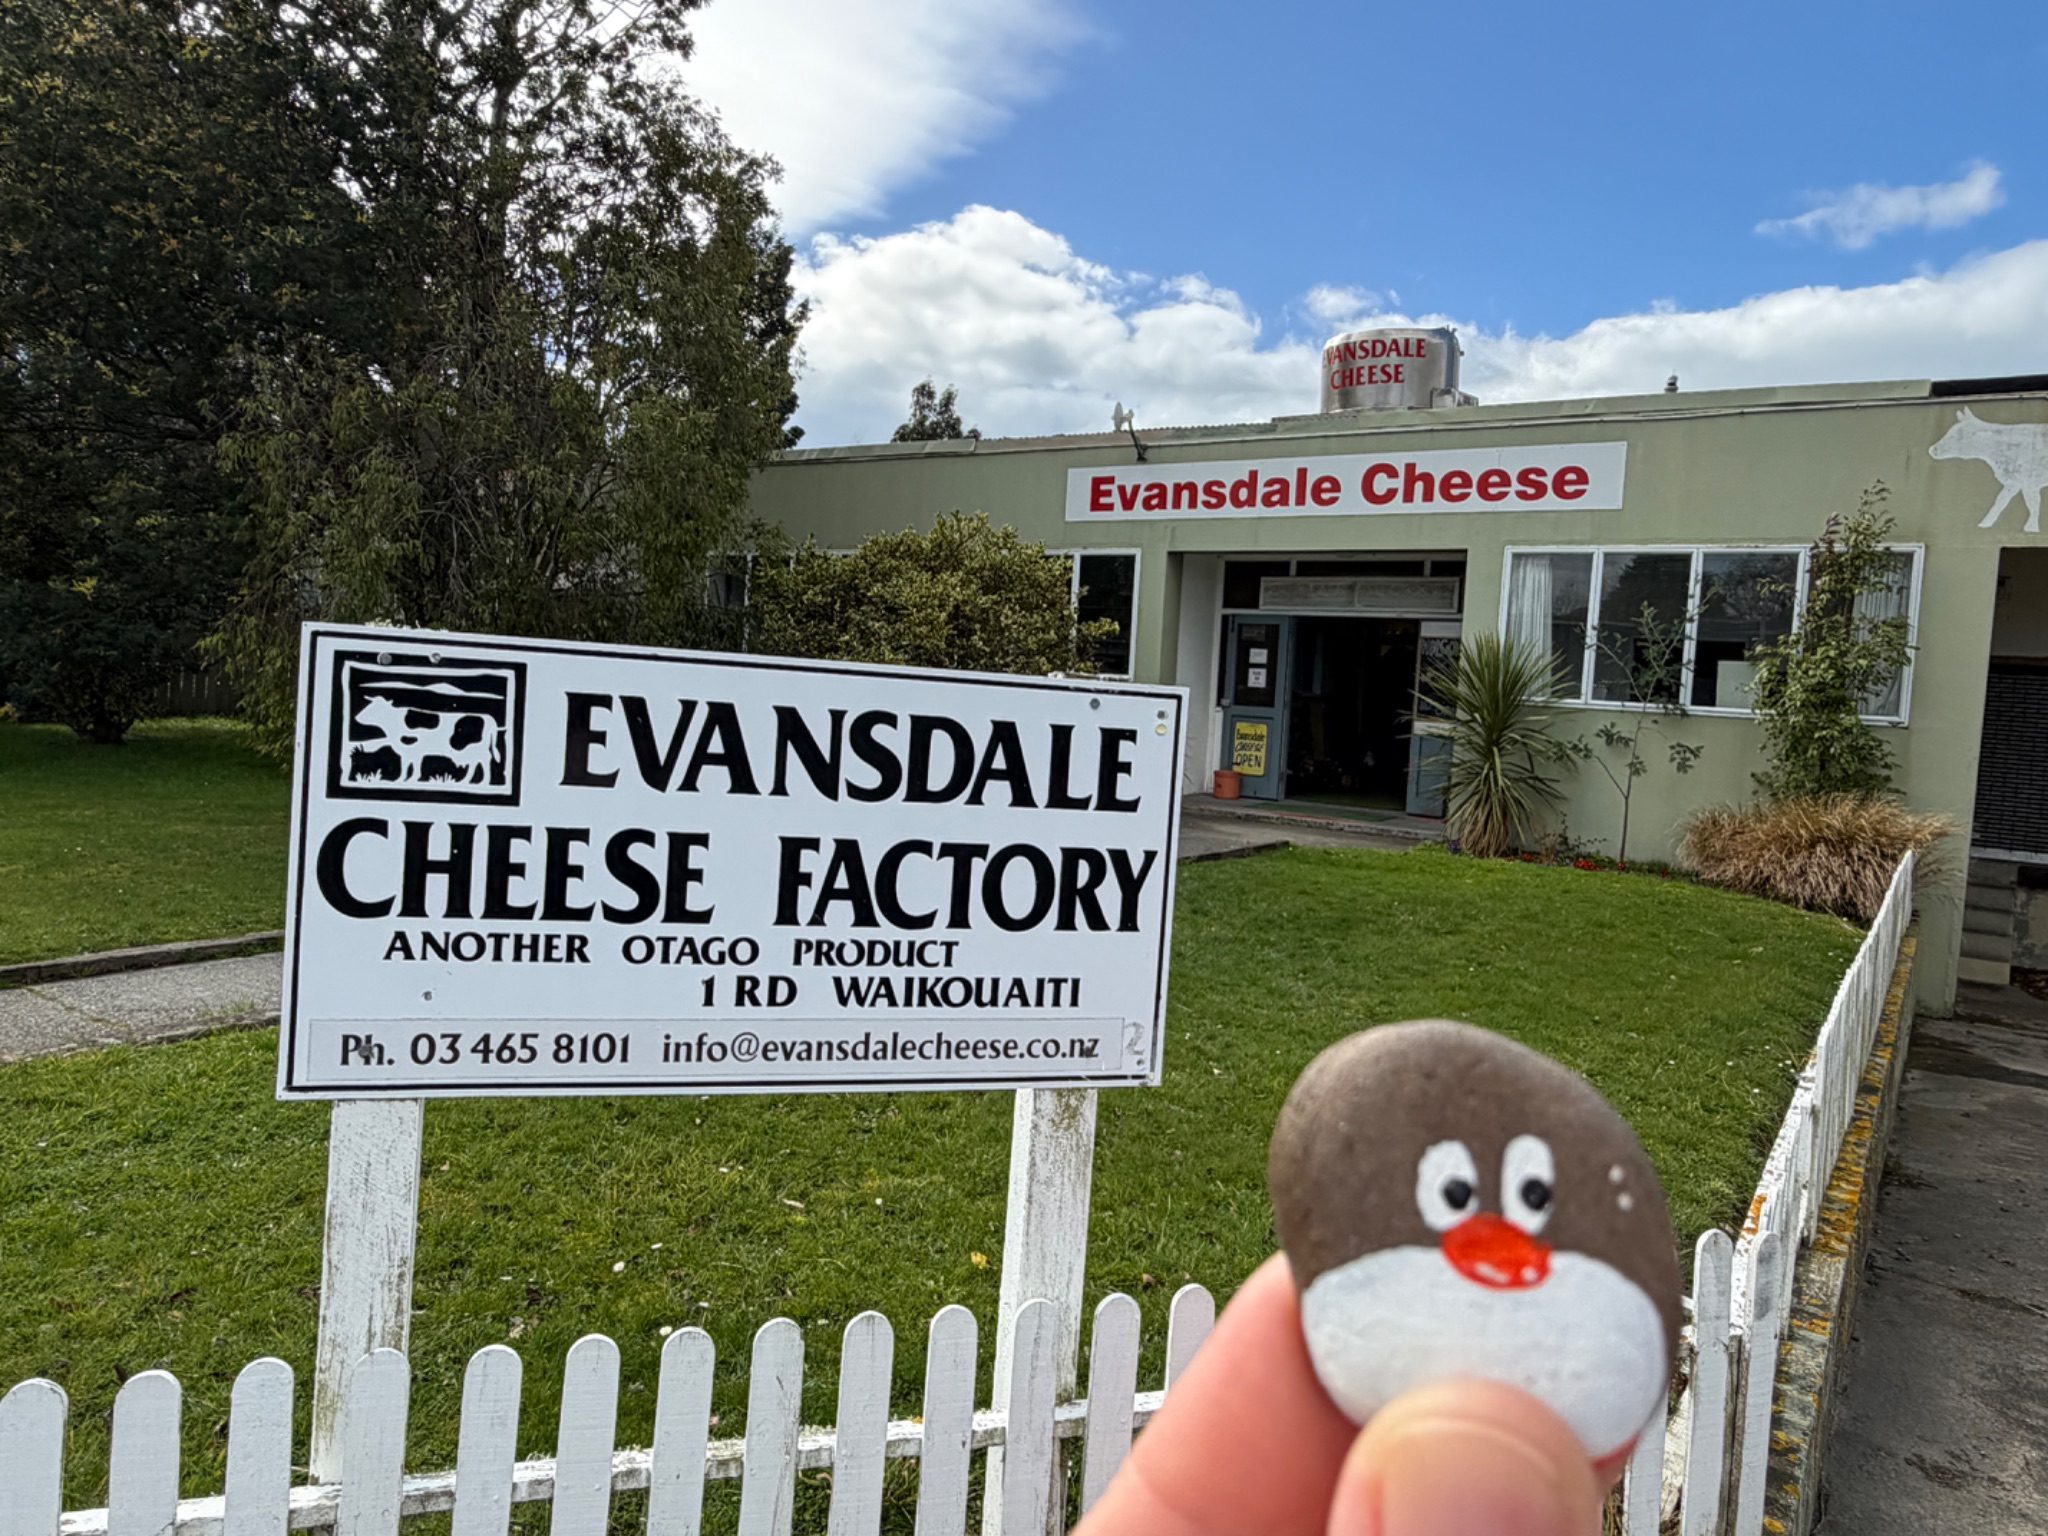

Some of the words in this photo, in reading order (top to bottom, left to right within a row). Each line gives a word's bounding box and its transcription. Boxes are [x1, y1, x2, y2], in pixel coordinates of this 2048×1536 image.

[1330, 363, 1404, 390] CHEESE
[1090, 467, 1342, 513] Evansdale
[1360, 462, 1590, 506] Cheese
[560, 690, 1141, 813] EVANSDALE
[1236, 752, 1263, 768] OPEN
[316, 816, 716, 925] CHEESE
[773, 836, 1159, 933] FACTORY
[383, 930, 591, 964] ANOTHER
[621, 935, 760, 967] OTAGO
[792, 938, 960, 968] PRODUCT
[702, 976, 715, 1007] 1
[734, 976, 798, 1007] RD
[832, 977, 1081, 1008] WAIKOUAITI
[340, 1033, 396, 1066] Ph.
[410, 1033, 463, 1065] 03
[470, 1032, 540, 1065] 465
[552, 1032, 631, 1065] 8101
[663, 1031, 1100, 1064] info@evansdalecheese.co.nz
